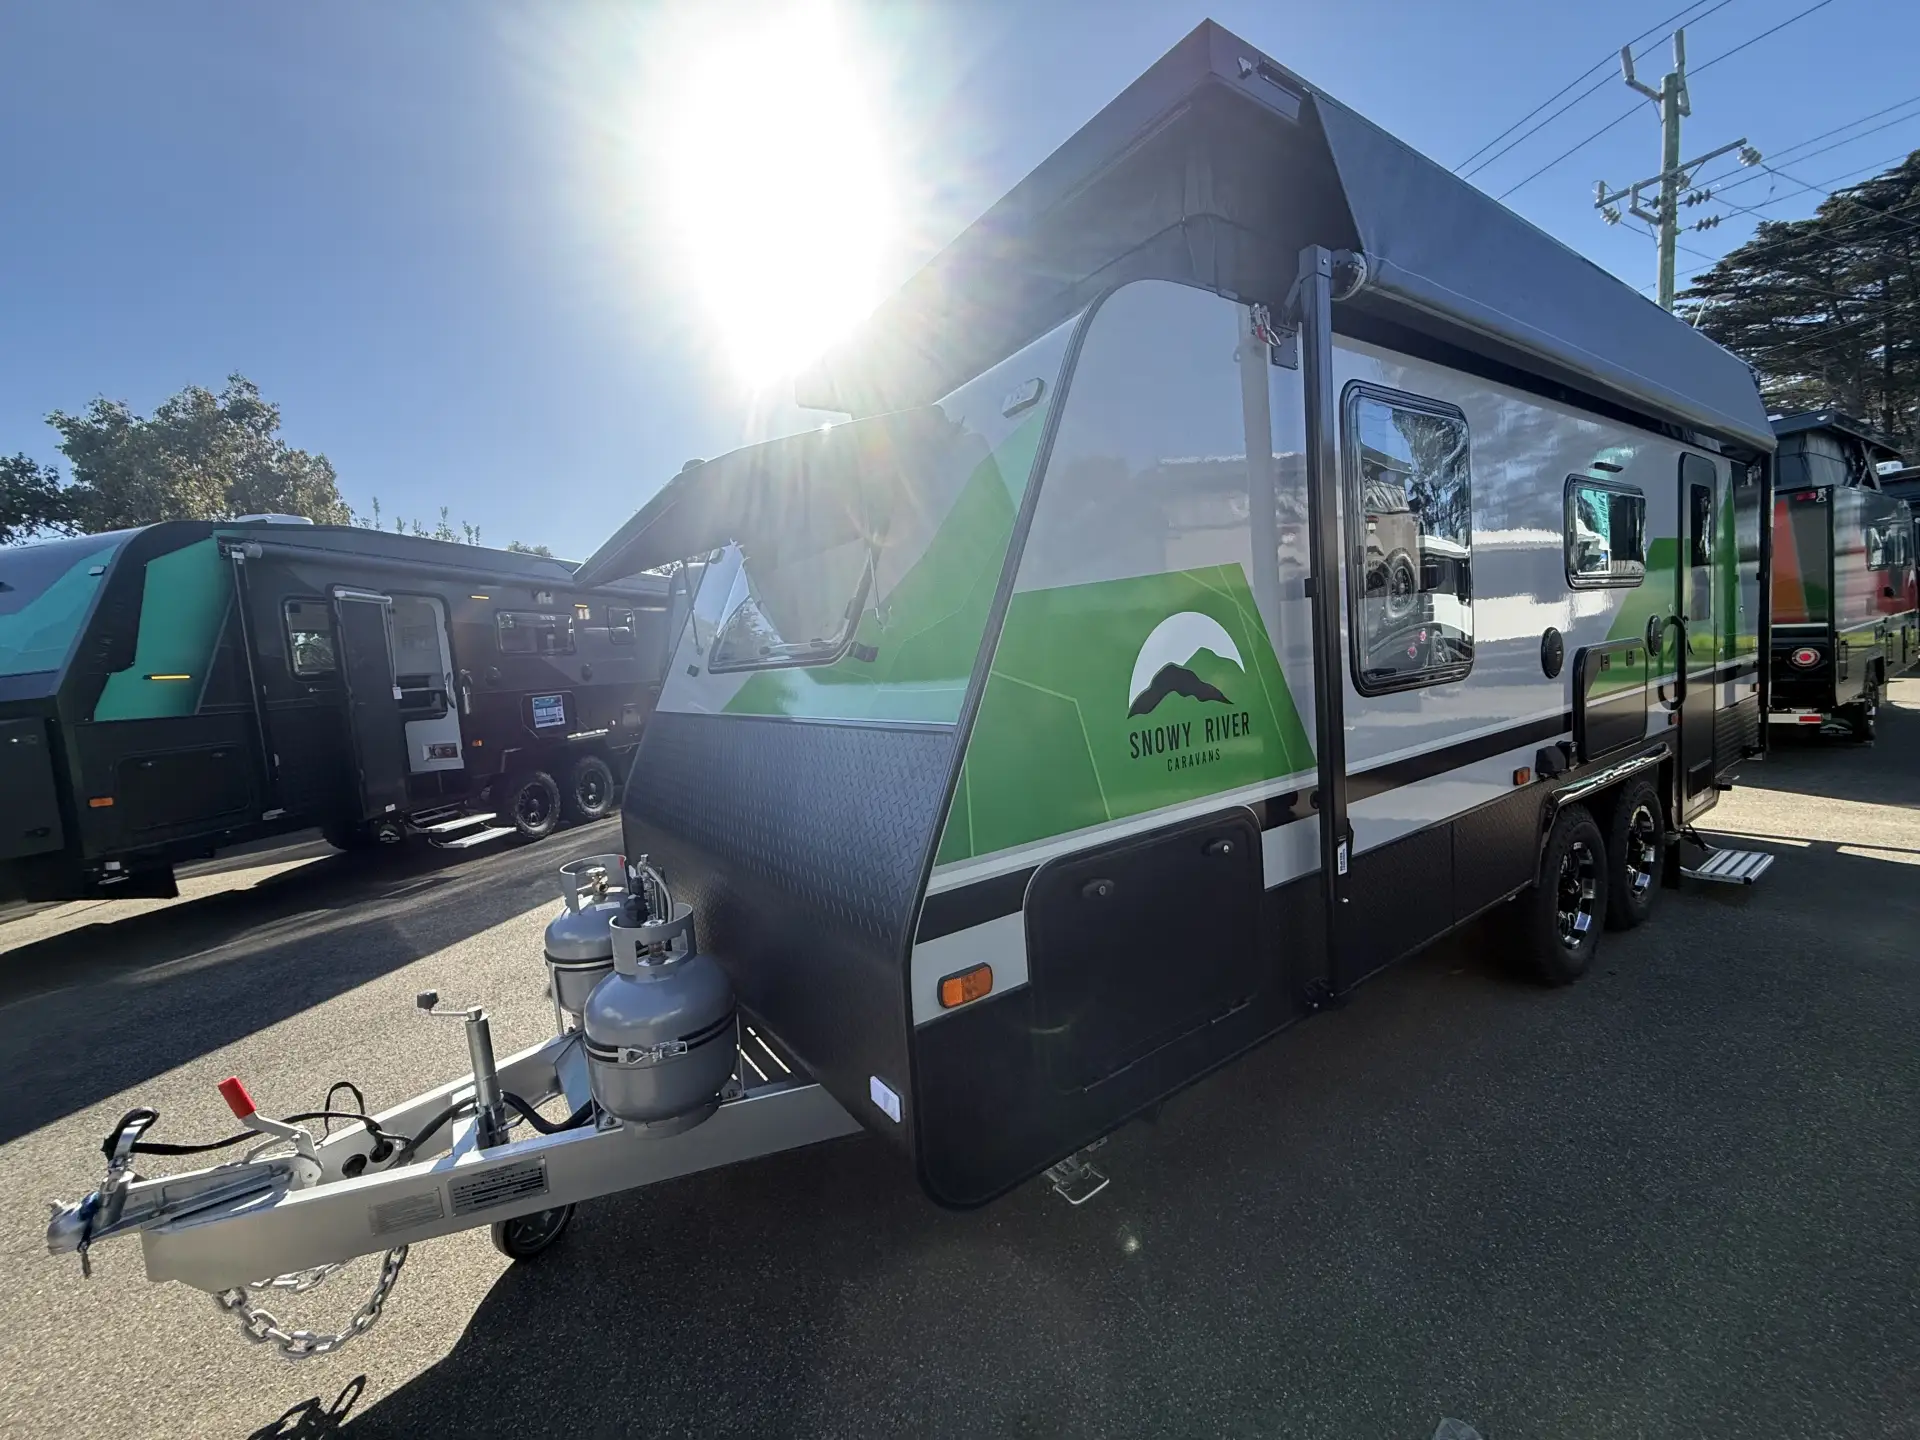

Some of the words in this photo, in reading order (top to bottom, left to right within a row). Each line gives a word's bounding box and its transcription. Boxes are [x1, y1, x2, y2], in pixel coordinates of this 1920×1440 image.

[1129, 722, 1191, 759] SNOWY
[1205, 712, 1250, 743] RIVER
[1167, 749, 1221, 772] CARAVANS
